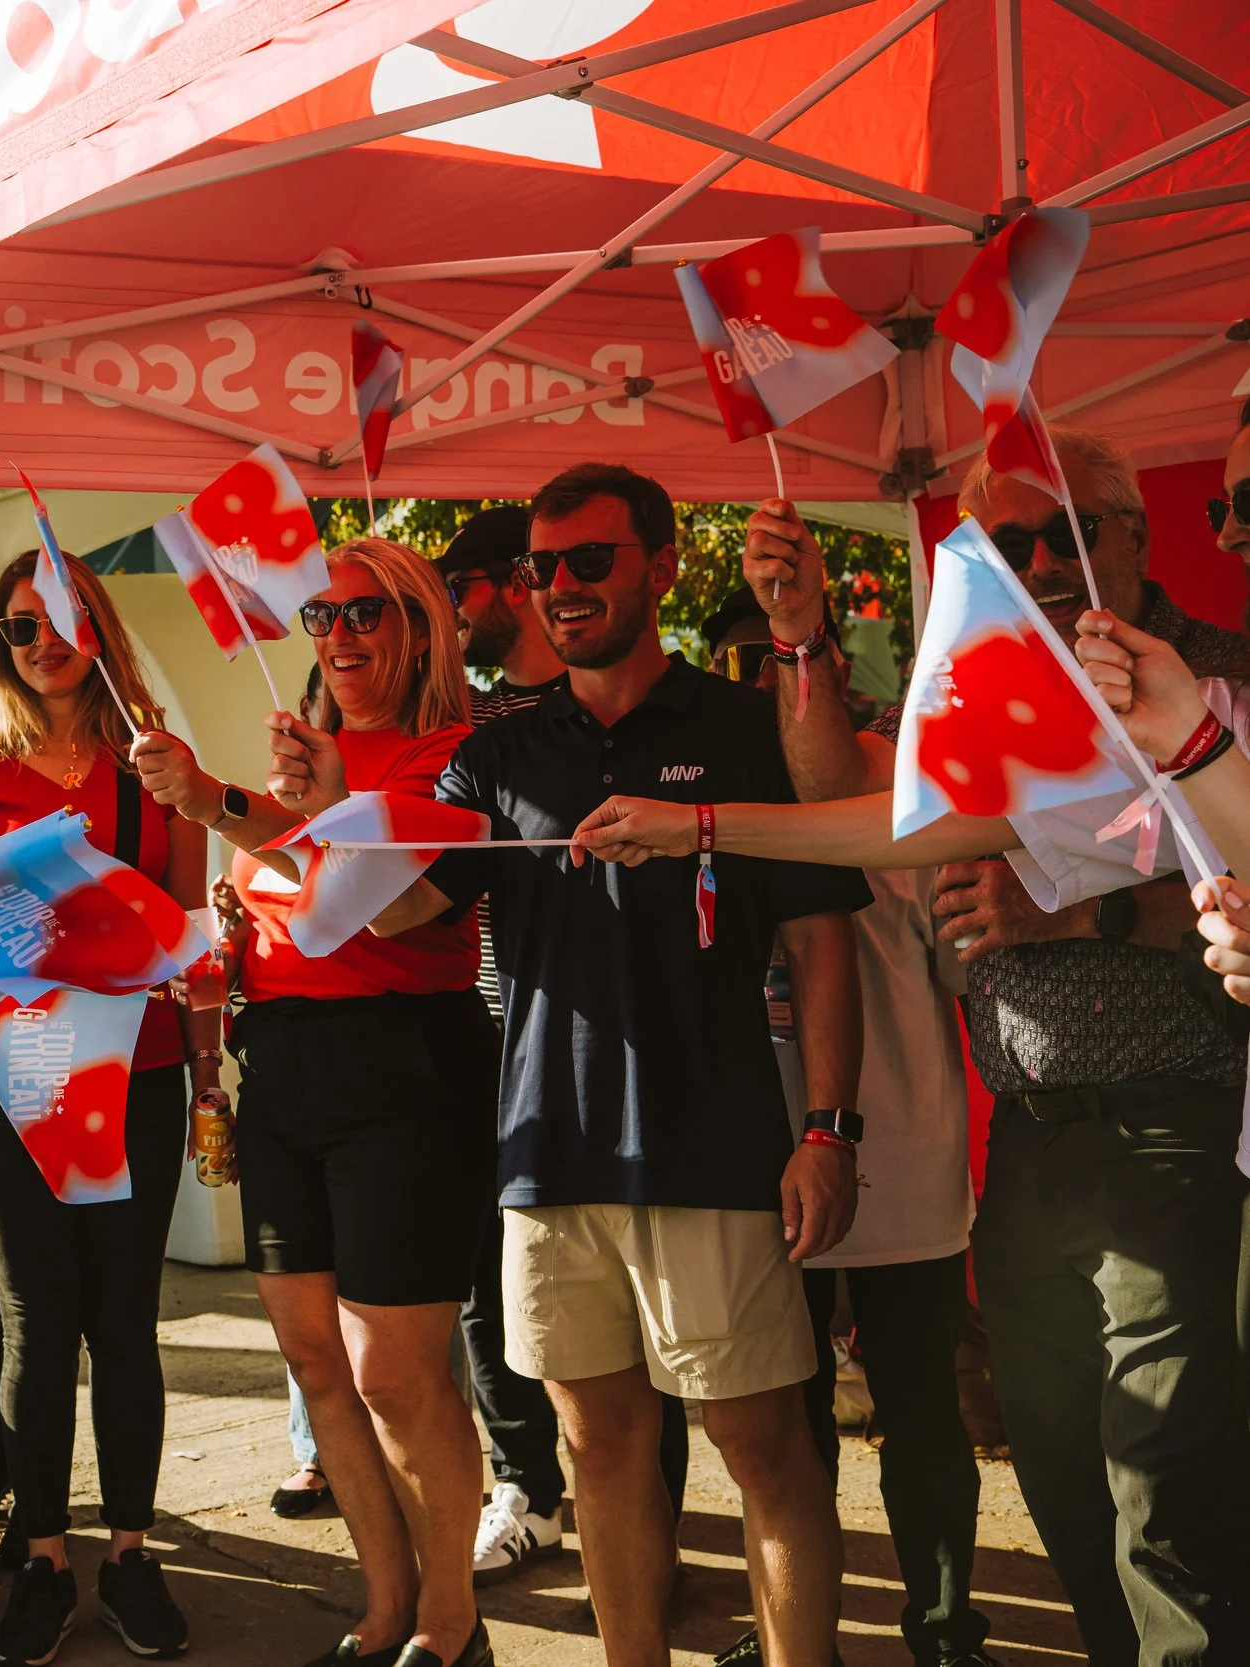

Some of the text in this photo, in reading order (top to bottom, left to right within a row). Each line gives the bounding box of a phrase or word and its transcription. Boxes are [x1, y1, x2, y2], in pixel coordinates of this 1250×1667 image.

[1182, 737, 1207, 765] Banque
[660, 765, 704, 782] MNP
[7, 1007, 49, 1121] GATINEAU
[37, 1031, 76, 1090] TOUR
[53, 1088, 65, 1101] DE
